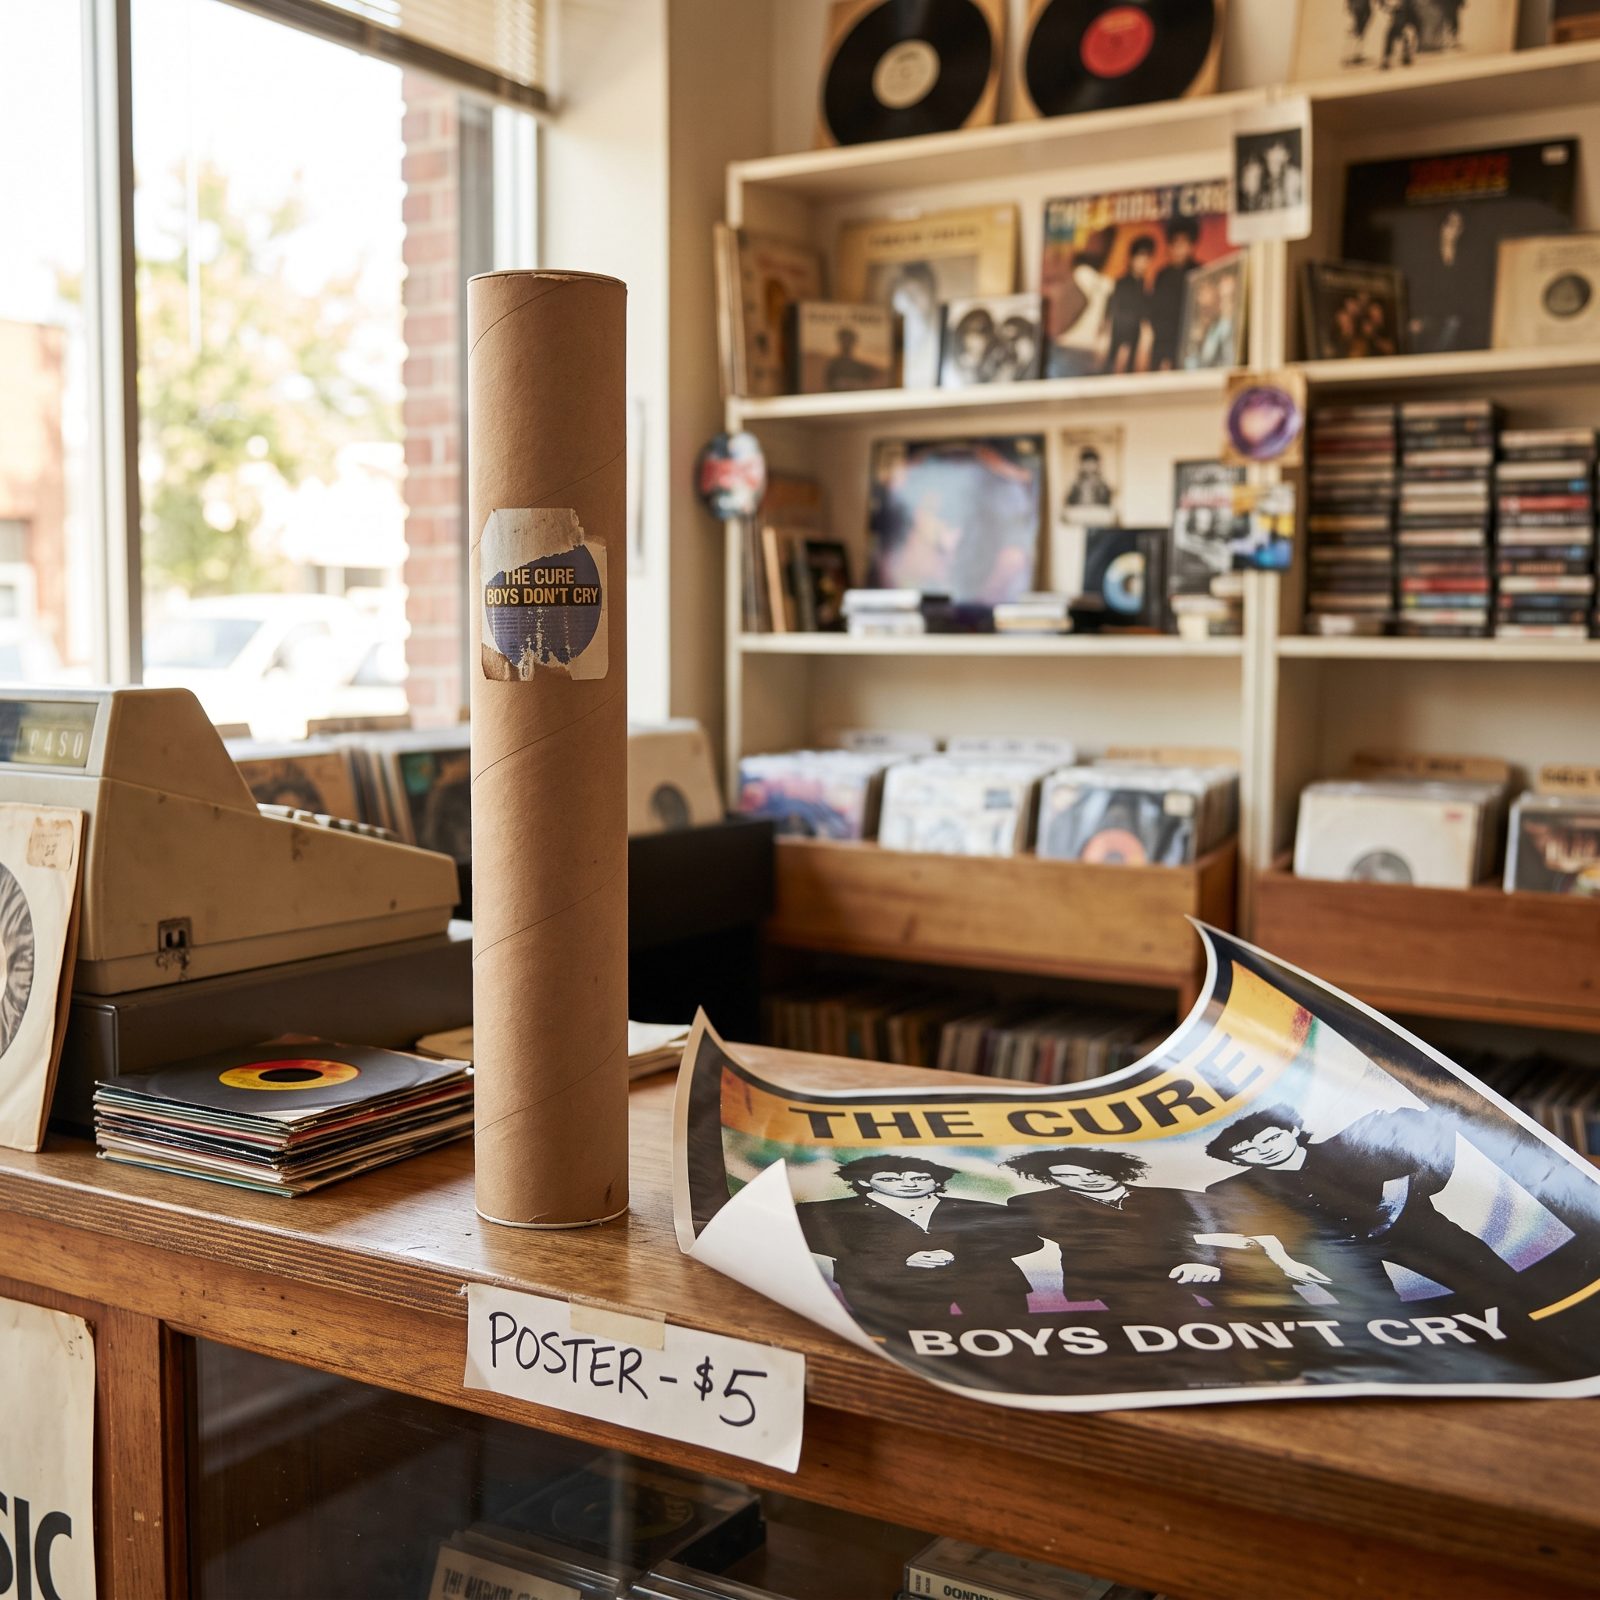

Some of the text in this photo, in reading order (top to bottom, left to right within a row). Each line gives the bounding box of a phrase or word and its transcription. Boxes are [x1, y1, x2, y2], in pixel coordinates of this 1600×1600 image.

[486, 587, 599, 605] BOYS DON'T CRY
[504, 568, 574, 585] THE CURE
[788, 1033, 1264, 1139] THE CURE
[908, 1307, 1507, 1357] BOYS DON'T CRY
[489, 1311, 648, 1400] POSTER
[694, 1355, 768, 1427] $5
